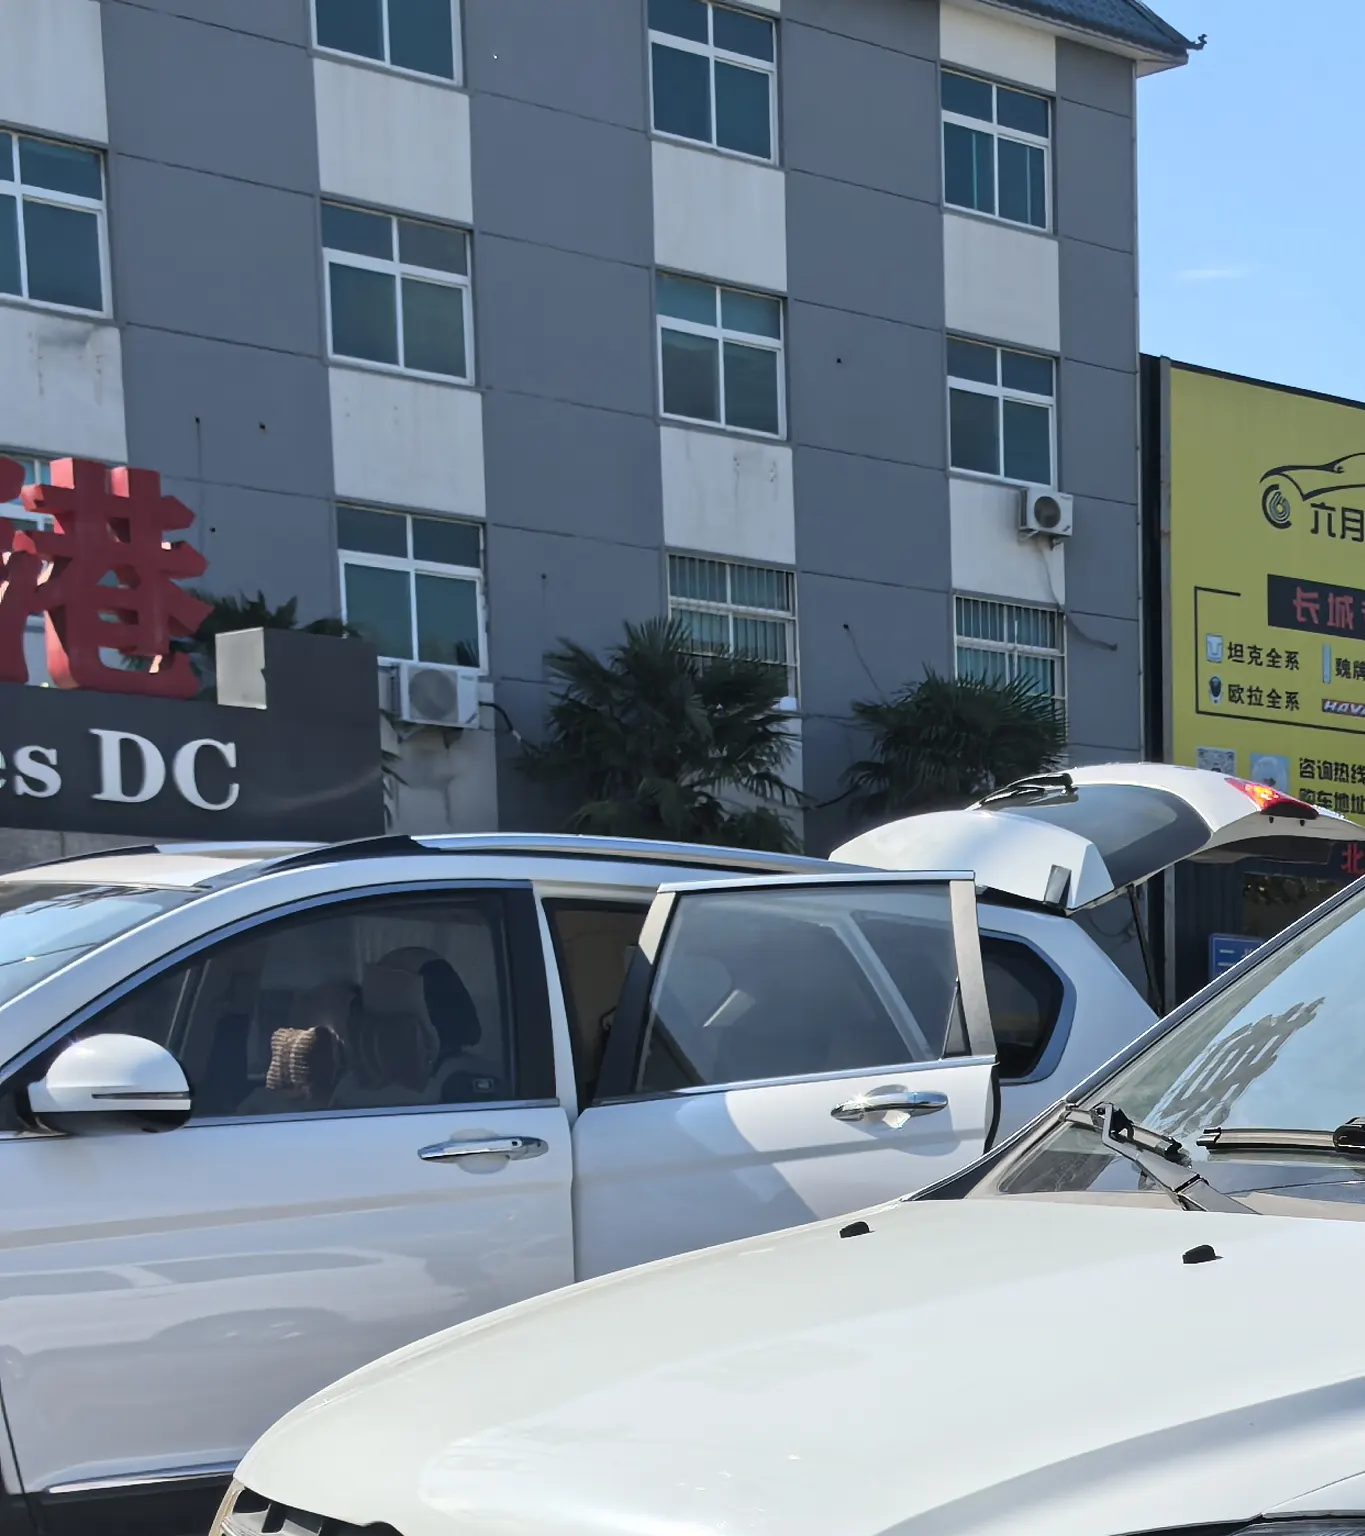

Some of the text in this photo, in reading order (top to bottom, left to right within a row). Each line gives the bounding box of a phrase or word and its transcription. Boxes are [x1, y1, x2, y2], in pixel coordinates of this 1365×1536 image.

[0, 455, 214, 700] 港
[1227, 641, 1300, 670] 坦克全系
[1227, 684, 1300, 711] 欧拉全系
[0, 728, 240, 811] s DC
